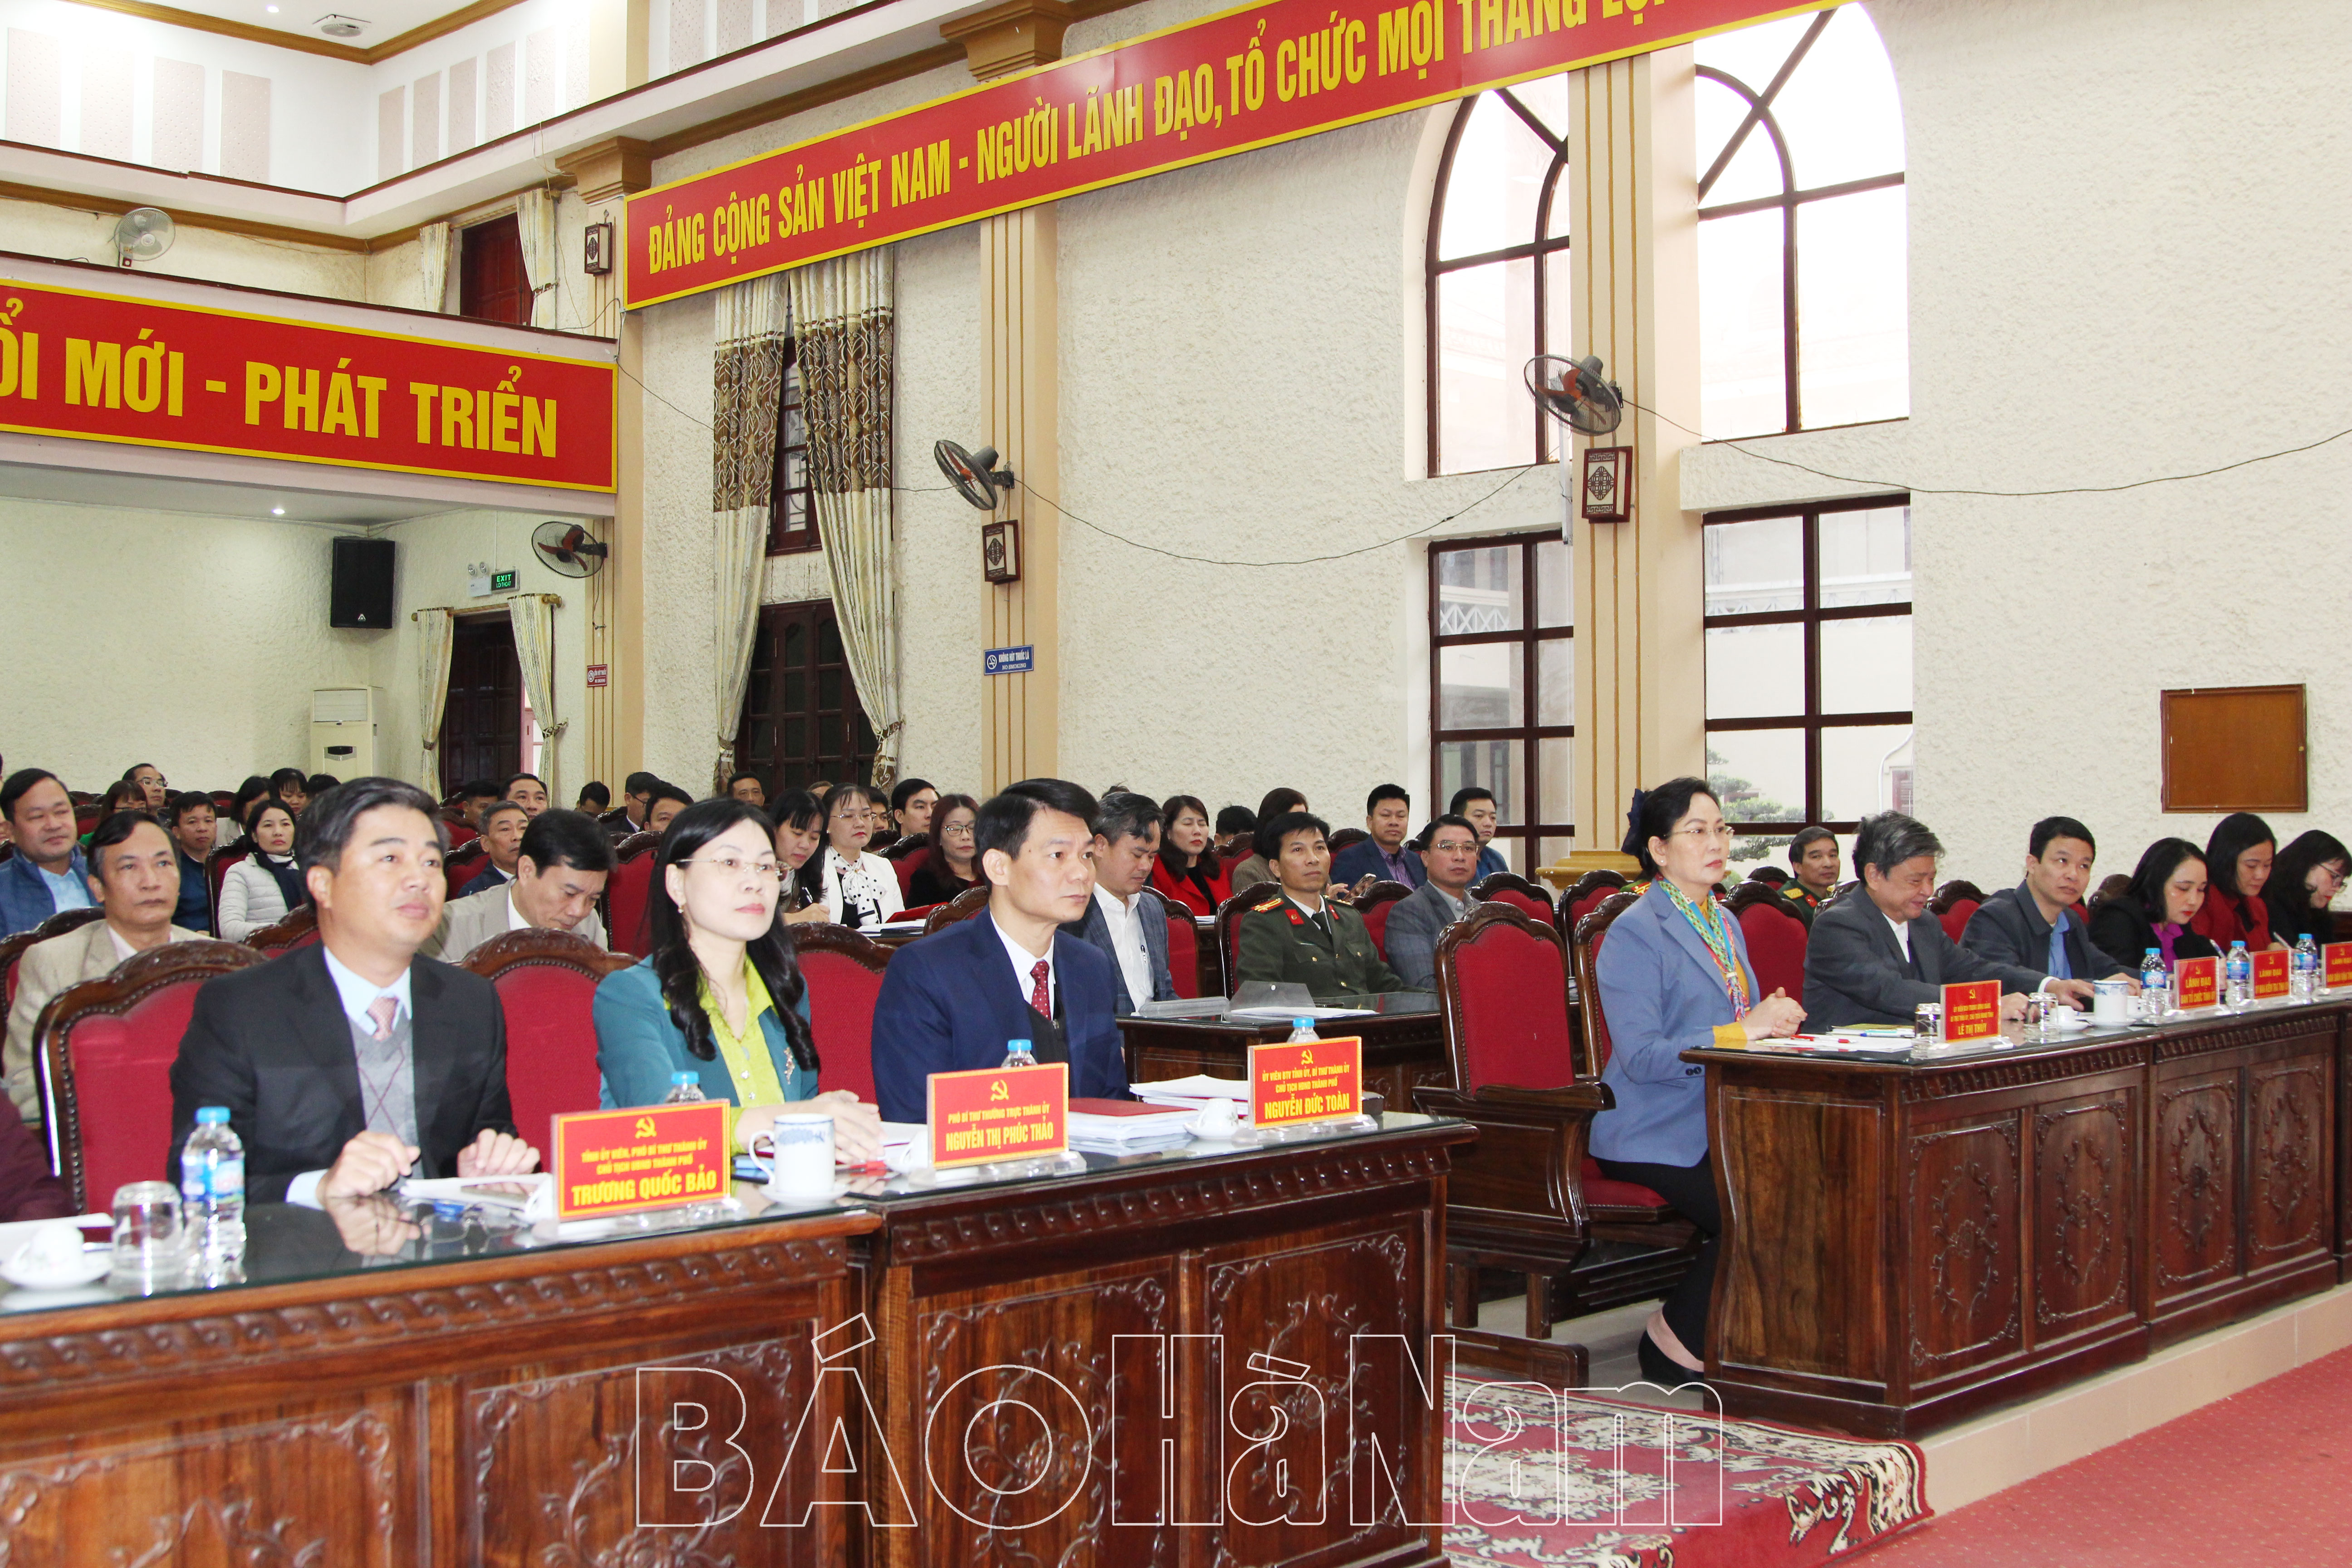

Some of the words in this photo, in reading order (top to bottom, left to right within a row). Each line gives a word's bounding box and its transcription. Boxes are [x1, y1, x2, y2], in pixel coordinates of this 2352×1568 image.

[649, 204, 705, 275] ĐẢNG
[713, 191, 770, 265] CỘNG
[778, 164, 824, 239] SẢN
[832, 153, 882, 229] VIỆT
[892, 138, 950, 208] NAM
[977, 96, 1058, 184] NGƯỜI
[1068, 84, 1144, 160] LÃNH
[1154, 63, 1222, 142] ĐẠO,
[1226, 18, 1266, 116] TỔ
[1277, 10, 1366, 103] CHỨC
[1378, 0, 1444, 80] MỌI
[65, 328, 184, 417] MỚI
[245, 357, 387, 439] PHÁT
[409, 365, 557, 458] TRIỂN
[496, 574, 512, 582] EXIT
[1958, 1024, 1965, 1035] LÊ
[1264, 1093, 1303, 1119] NGUYỄN
[1304, 1092, 1323, 1115] ĐỨC
[1325, 1090, 1350, 1112] TOÀN
[946, 1123, 984, 1152] NGUYỄN
[986, 1127, 1001, 1149] THỊ
[1003, 1122, 1029, 1145] PHÚC
[1030, 1115, 1054, 1141] THẢO
[571, 1179, 636, 1206] TRƯƠNG
[639, 1168, 682, 1200] QUỐC
[685, 1164, 717, 1193] BẢO
